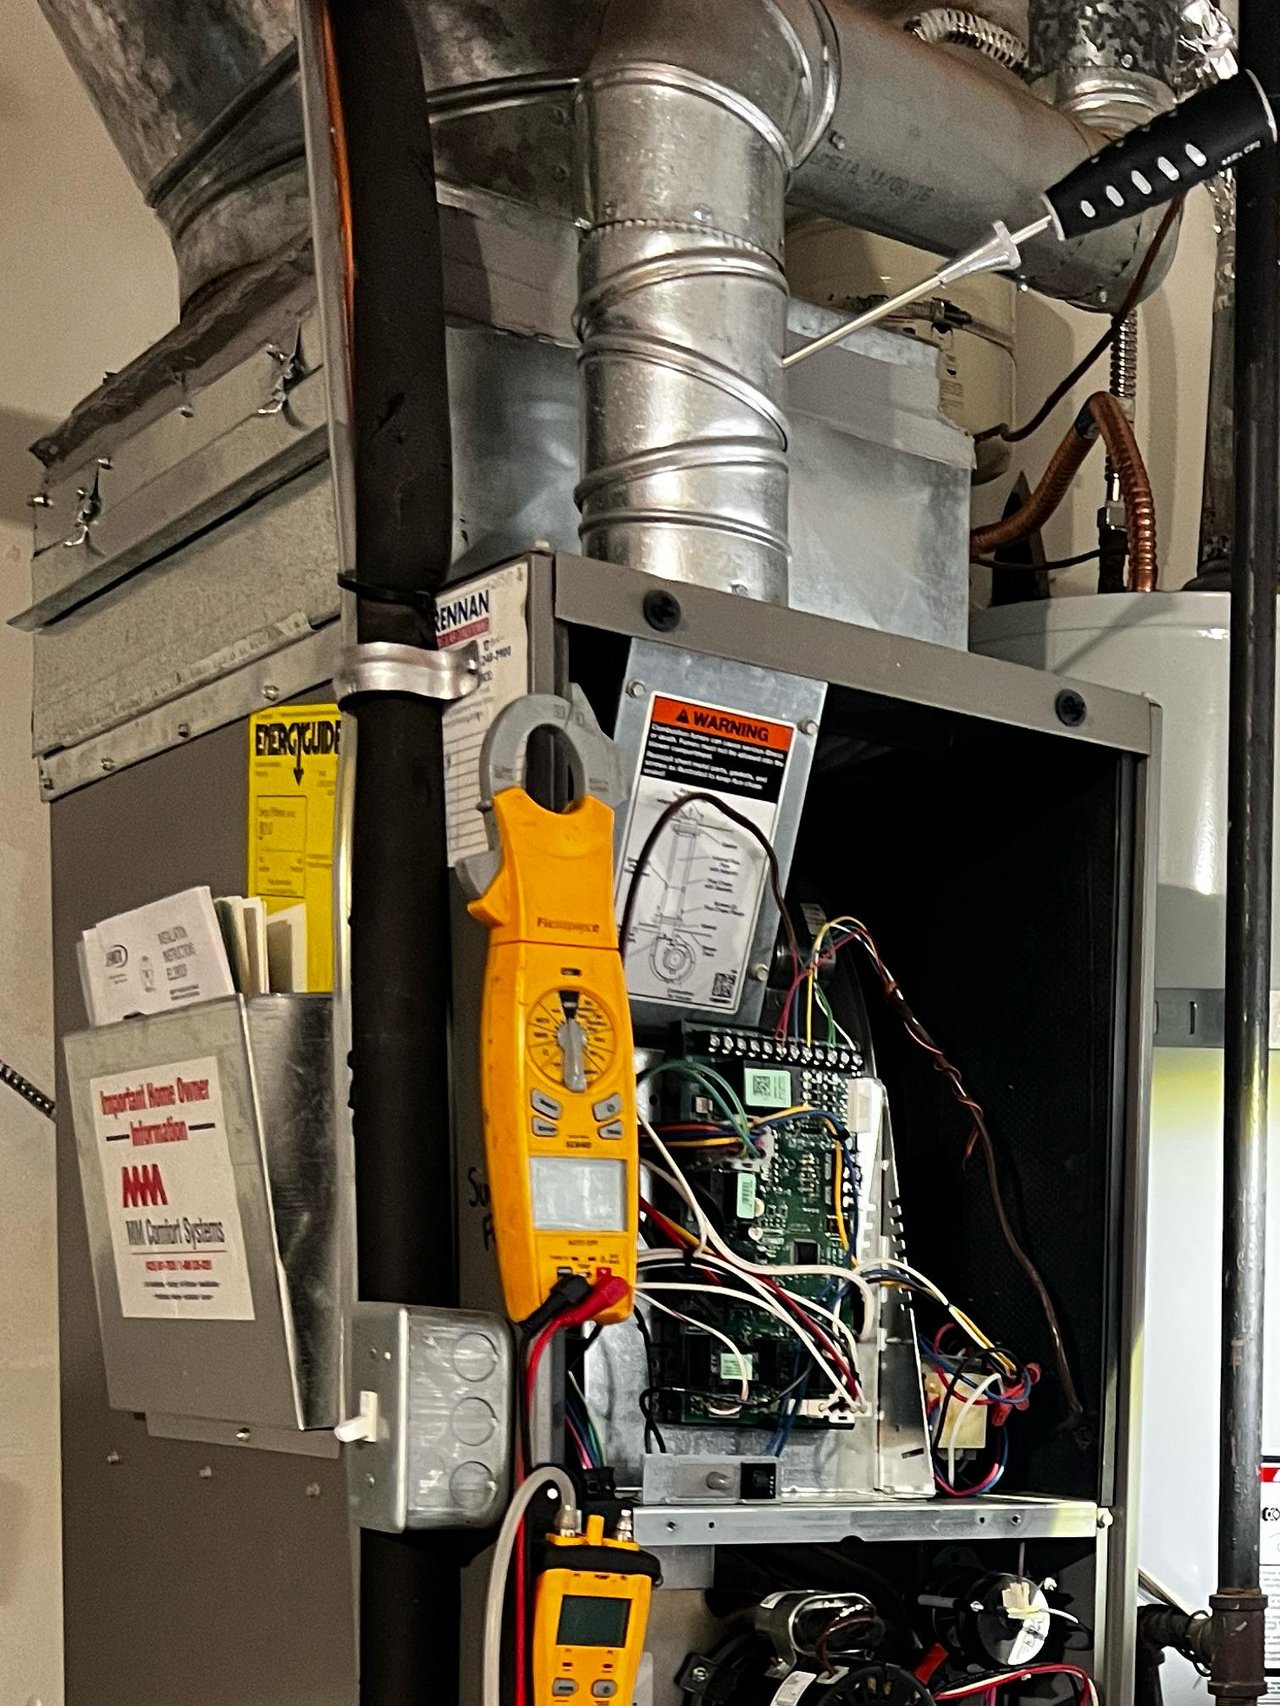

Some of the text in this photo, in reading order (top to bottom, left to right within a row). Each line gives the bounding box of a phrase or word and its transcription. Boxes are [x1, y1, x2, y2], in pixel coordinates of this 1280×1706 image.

[435, 589, 489, 632] RENNAN
[694, 711, 769, 742] WARNING
[100, 1077, 209, 1119] Important Home Owner
[130, 1116, 188, 1146] Information
[146, 1218, 182, 1244] Comfort
[182, 1217, 225, 1250] Systems
